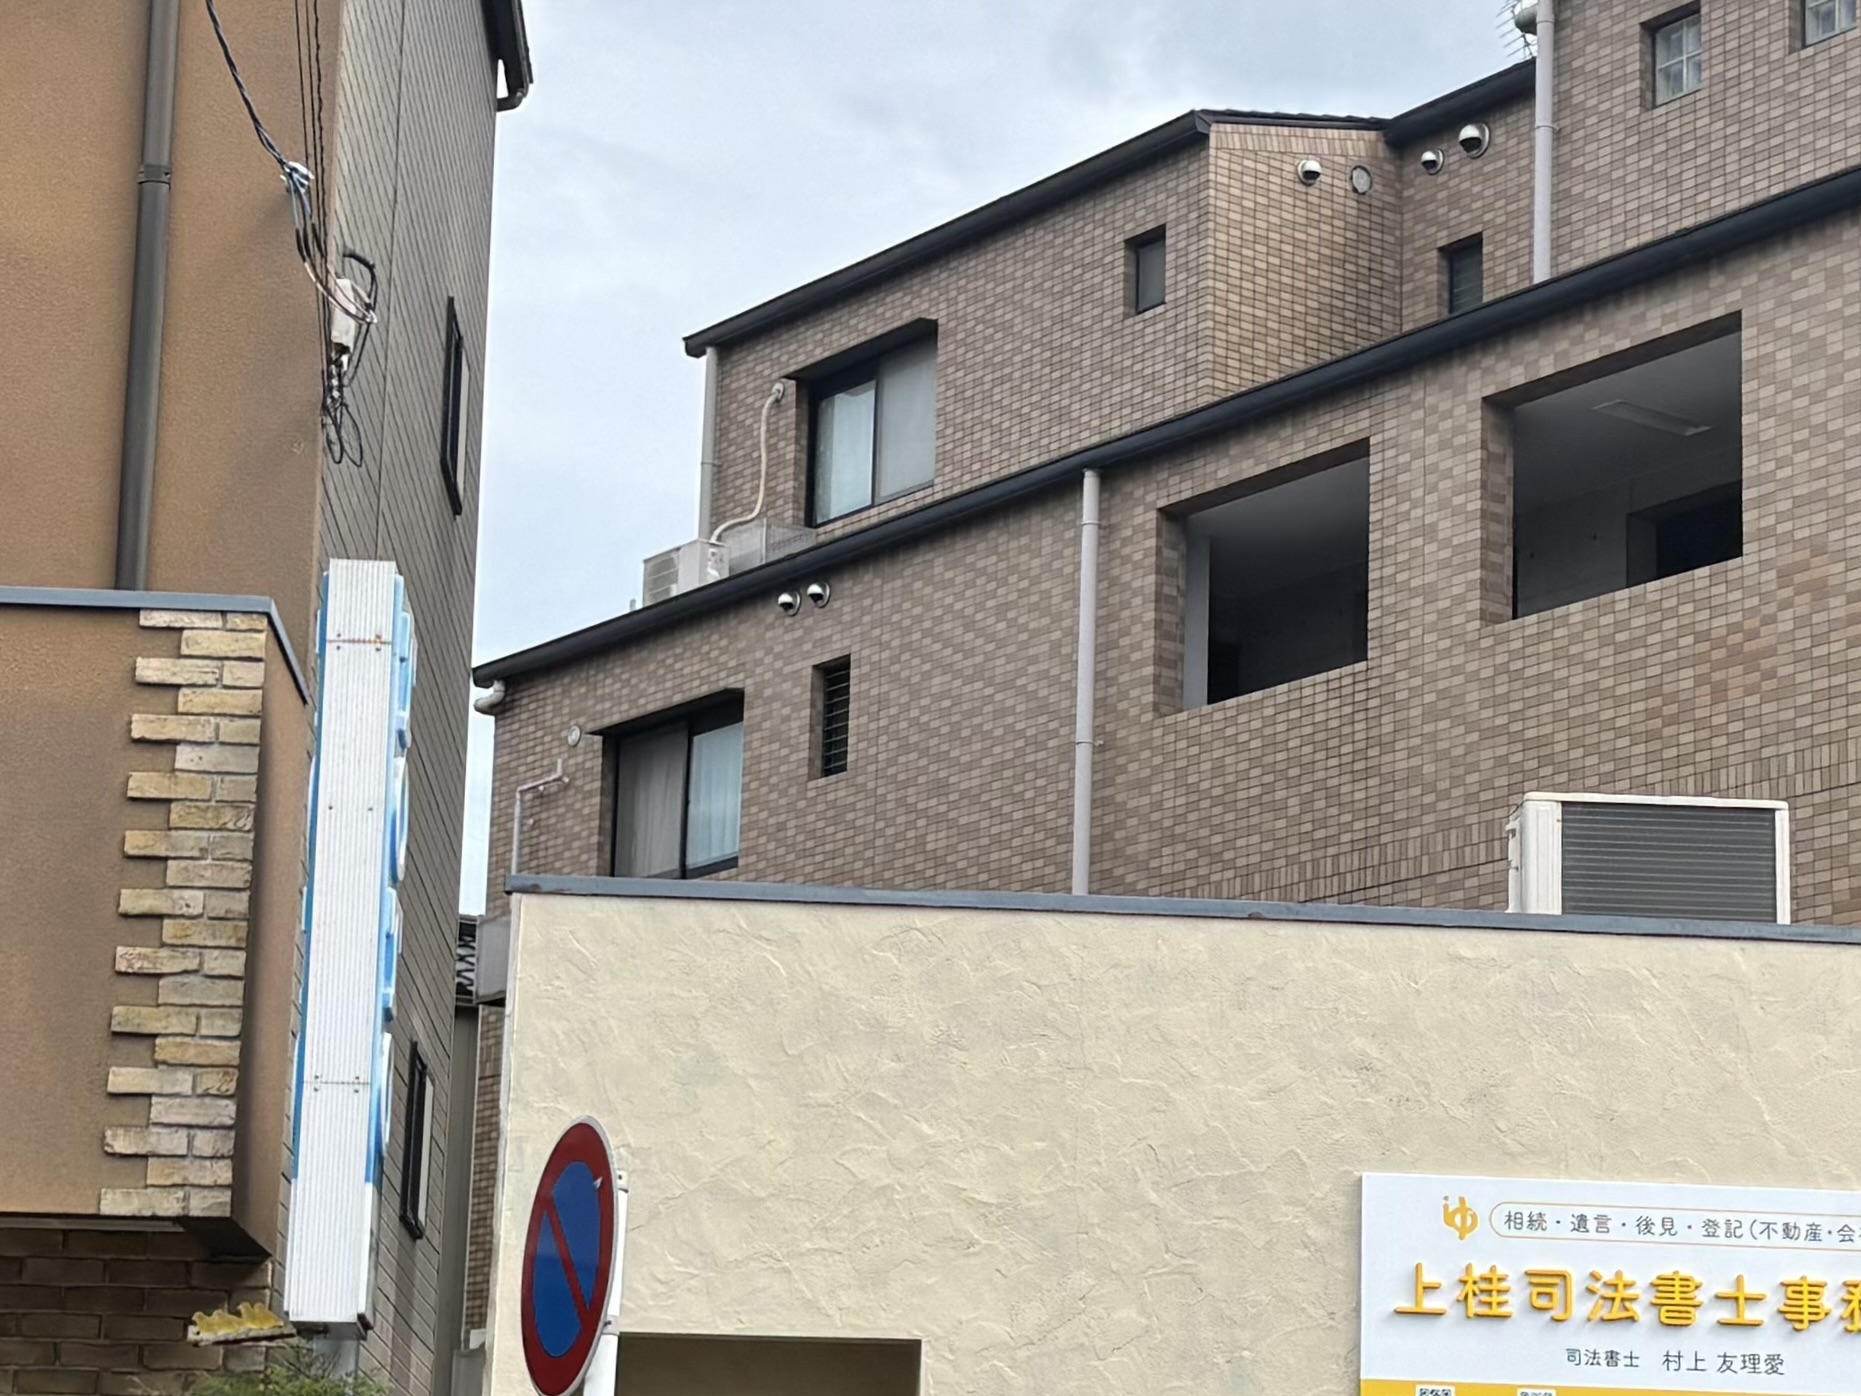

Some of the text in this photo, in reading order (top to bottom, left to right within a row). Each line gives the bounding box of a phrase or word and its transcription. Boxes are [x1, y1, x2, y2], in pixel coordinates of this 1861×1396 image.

[1565, 1348, 1785, 1375] 司法書士 村上 友理愛
